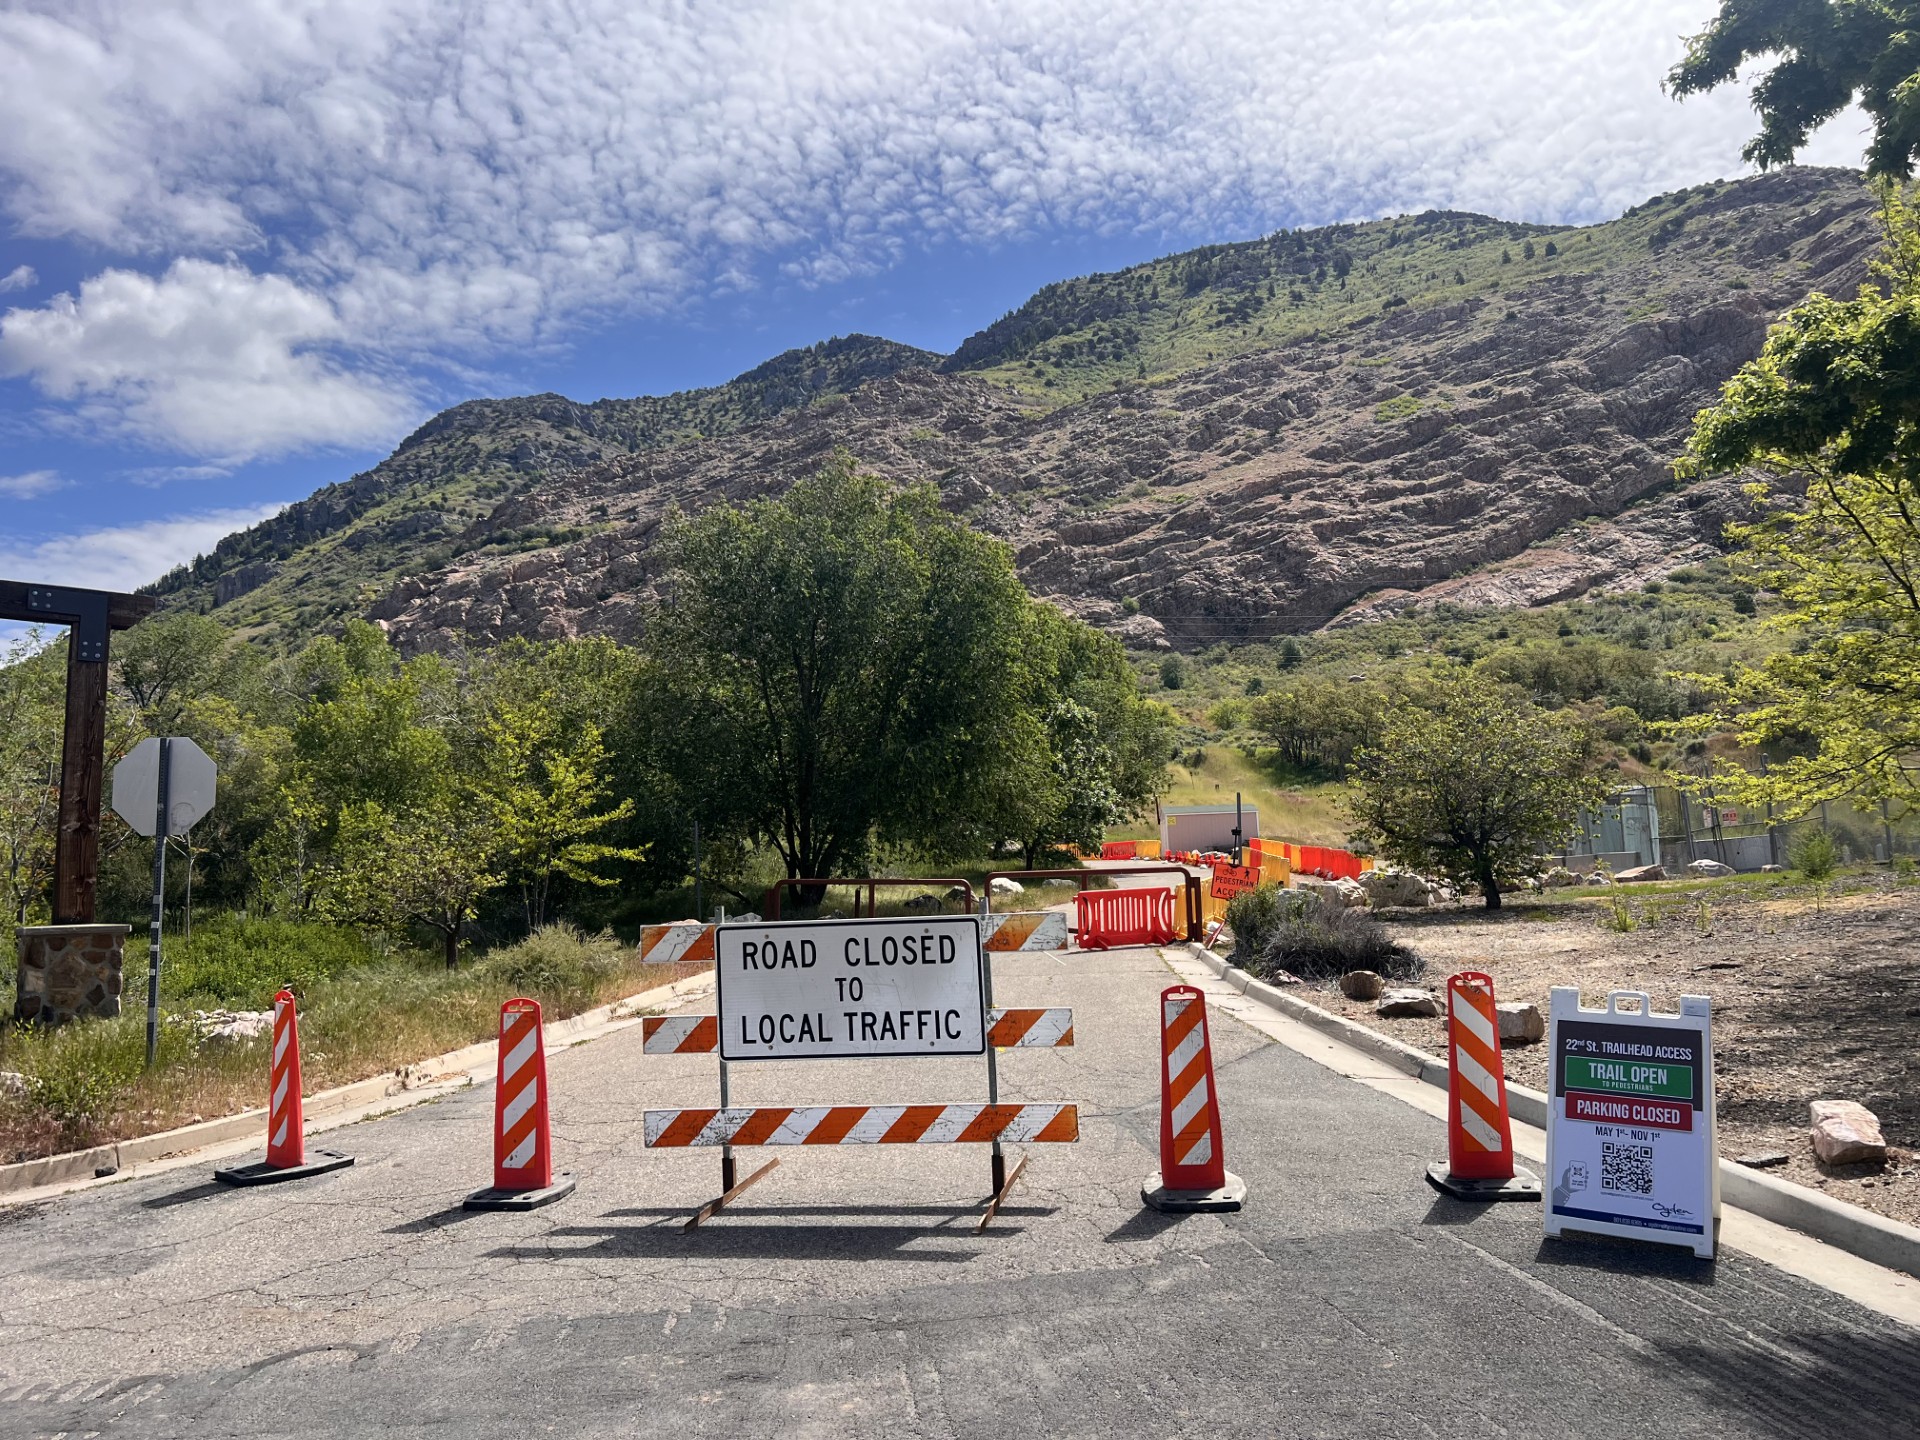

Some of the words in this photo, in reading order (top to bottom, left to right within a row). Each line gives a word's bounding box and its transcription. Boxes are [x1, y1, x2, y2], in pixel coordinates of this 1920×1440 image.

[742, 940, 817, 970] ROAD
[844, 934, 956, 967] CLOSED
[834, 977, 864, 1002] TO
[741, 1012, 833, 1044] LOCAL
[843, 1009, 962, 1041] TRAFFIC
[1565, 1039, 1585, 1051] 22nd
[1586, 1040, 1600, 1053] St.
[1601, 1041, 1653, 1057] TRAILHEAD
[1655, 1046, 1692, 1060] ACCESS
[1588, 1062, 1627, 1081] TRAIL
[1630, 1066, 1668, 1085] OPEN
[1602, 1080, 1610, 1088] TO
[1611, 1081, 1654, 1092] PEDESTRIANS
[1576, 1099, 1629, 1119] PARKING
[1632, 1105, 1680, 1124] CLOSED
[1595, 1125, 1613, 1137] MAY
[1631, 1129, 1649, 1141] NOV
[1650, 1132, 1661, 1142] 1st
[1651, 1202, 1694, 1218] Ogden
